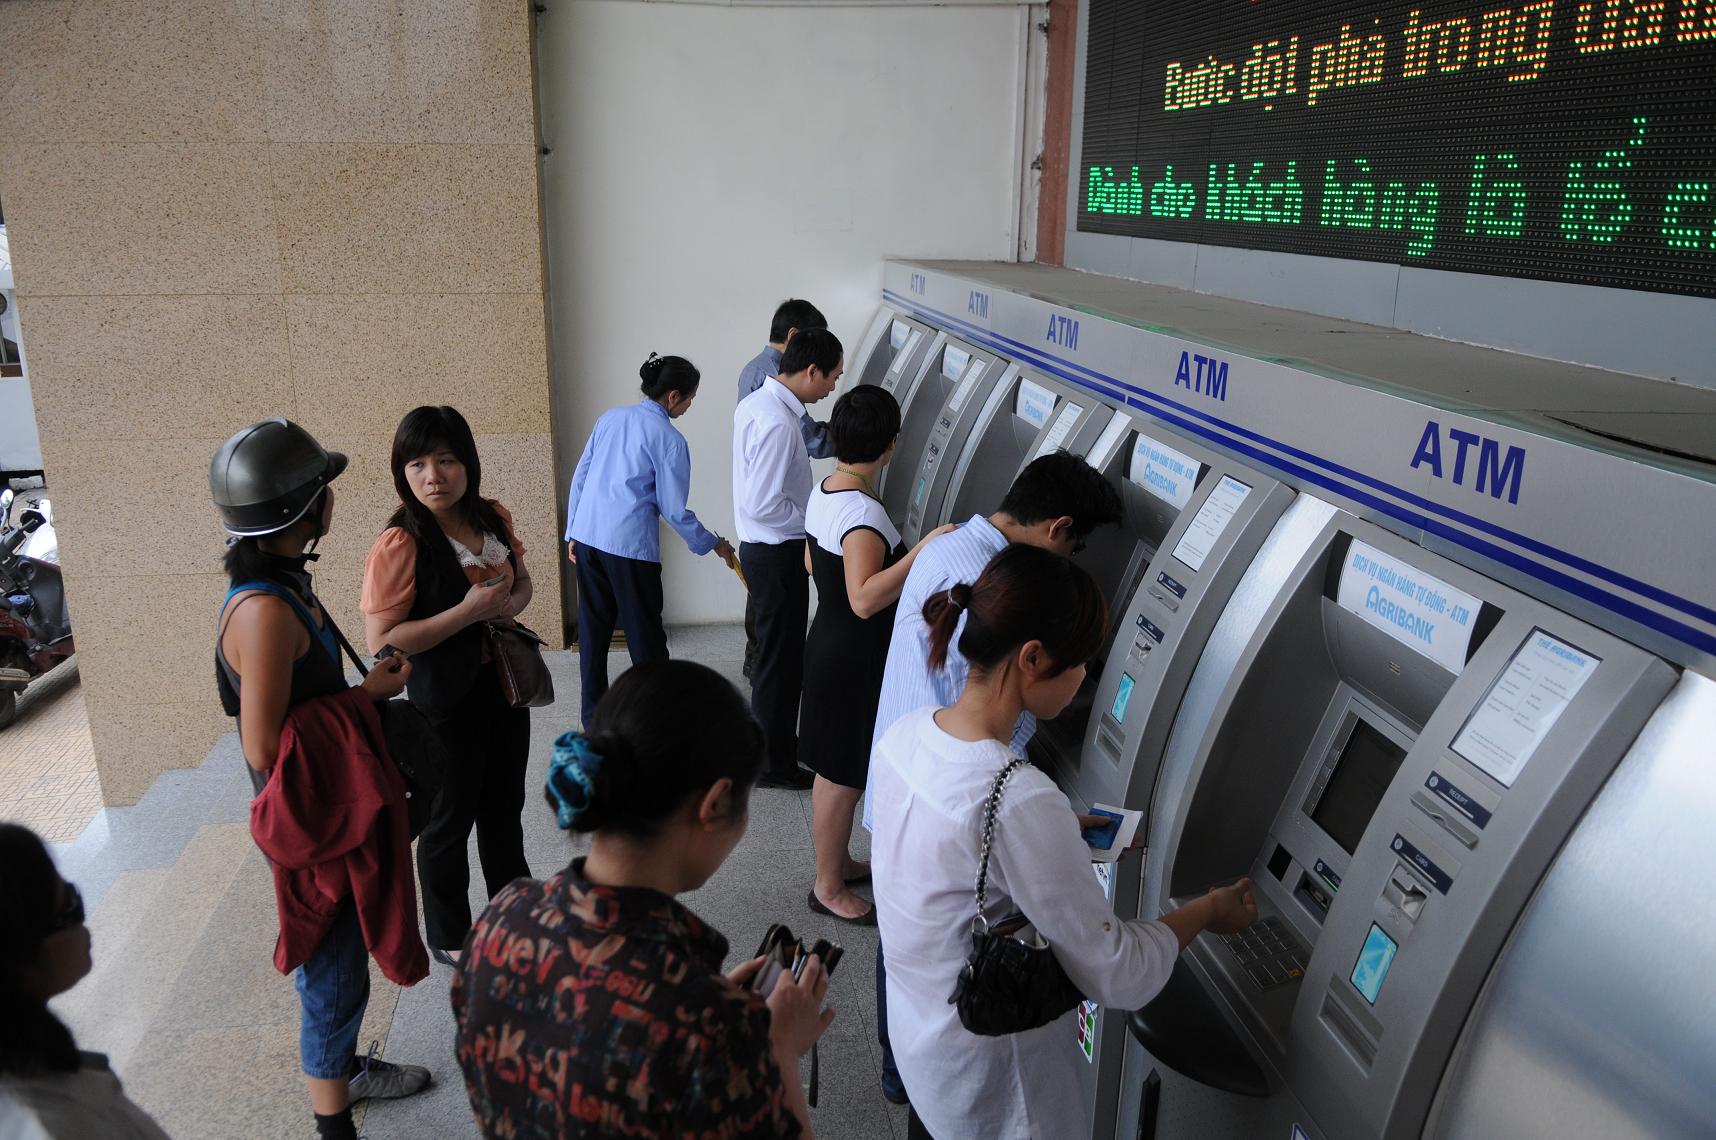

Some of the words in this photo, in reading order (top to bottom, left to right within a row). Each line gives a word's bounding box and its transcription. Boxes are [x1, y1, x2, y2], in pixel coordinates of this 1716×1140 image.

[1403, 1, 1553, 81] trong
[1151, 166, 1195, 217] cho
[1206, 162, 1302, 223] khách
[1320, 159, 1438, 256] hàng
[911, 273, 926, 297] ATM
[968, 290, 989, 319] ATM
[1046, 314, 1080, 351] ATM
[1174, 351, 1229, 402] ATM
[1410, 420, 1526, 505] ATM
[1450, 604, 1470, 626] ATM
